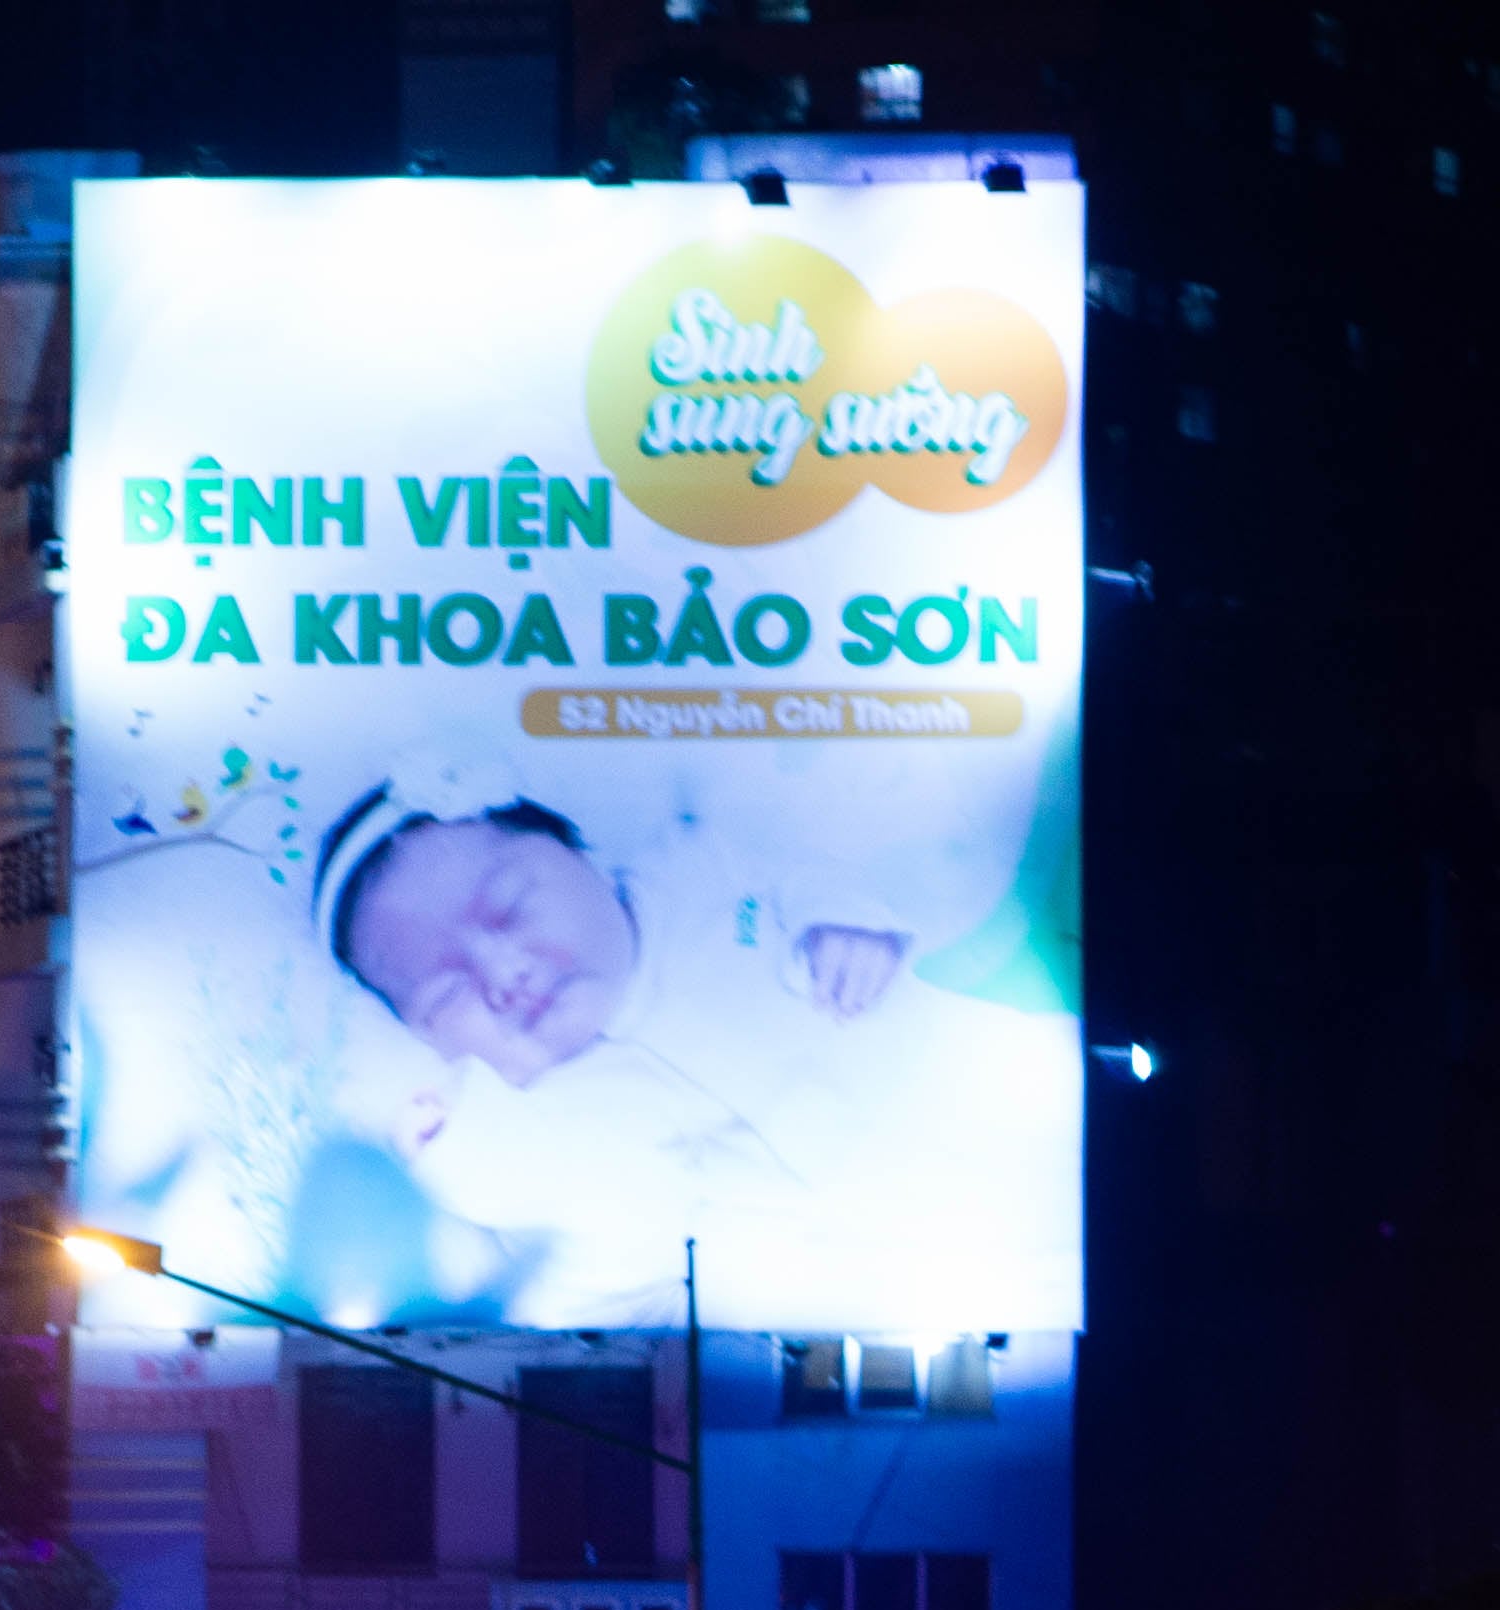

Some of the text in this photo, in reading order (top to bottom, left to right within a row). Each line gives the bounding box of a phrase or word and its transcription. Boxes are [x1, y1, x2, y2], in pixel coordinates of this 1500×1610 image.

[650, 288, 825, 385] Sinh
[639, 392, 814, 486] sung
[122, 455, 612, 570] BỆNH VIỆN
[120, 566, 1038, 667] ĐA KHOA BẢO SƠN
[615, 690, 767, 738] Nguyễn
[772, 694, 843, 732] Chí
[848, 694, 971, 732] Thanh
